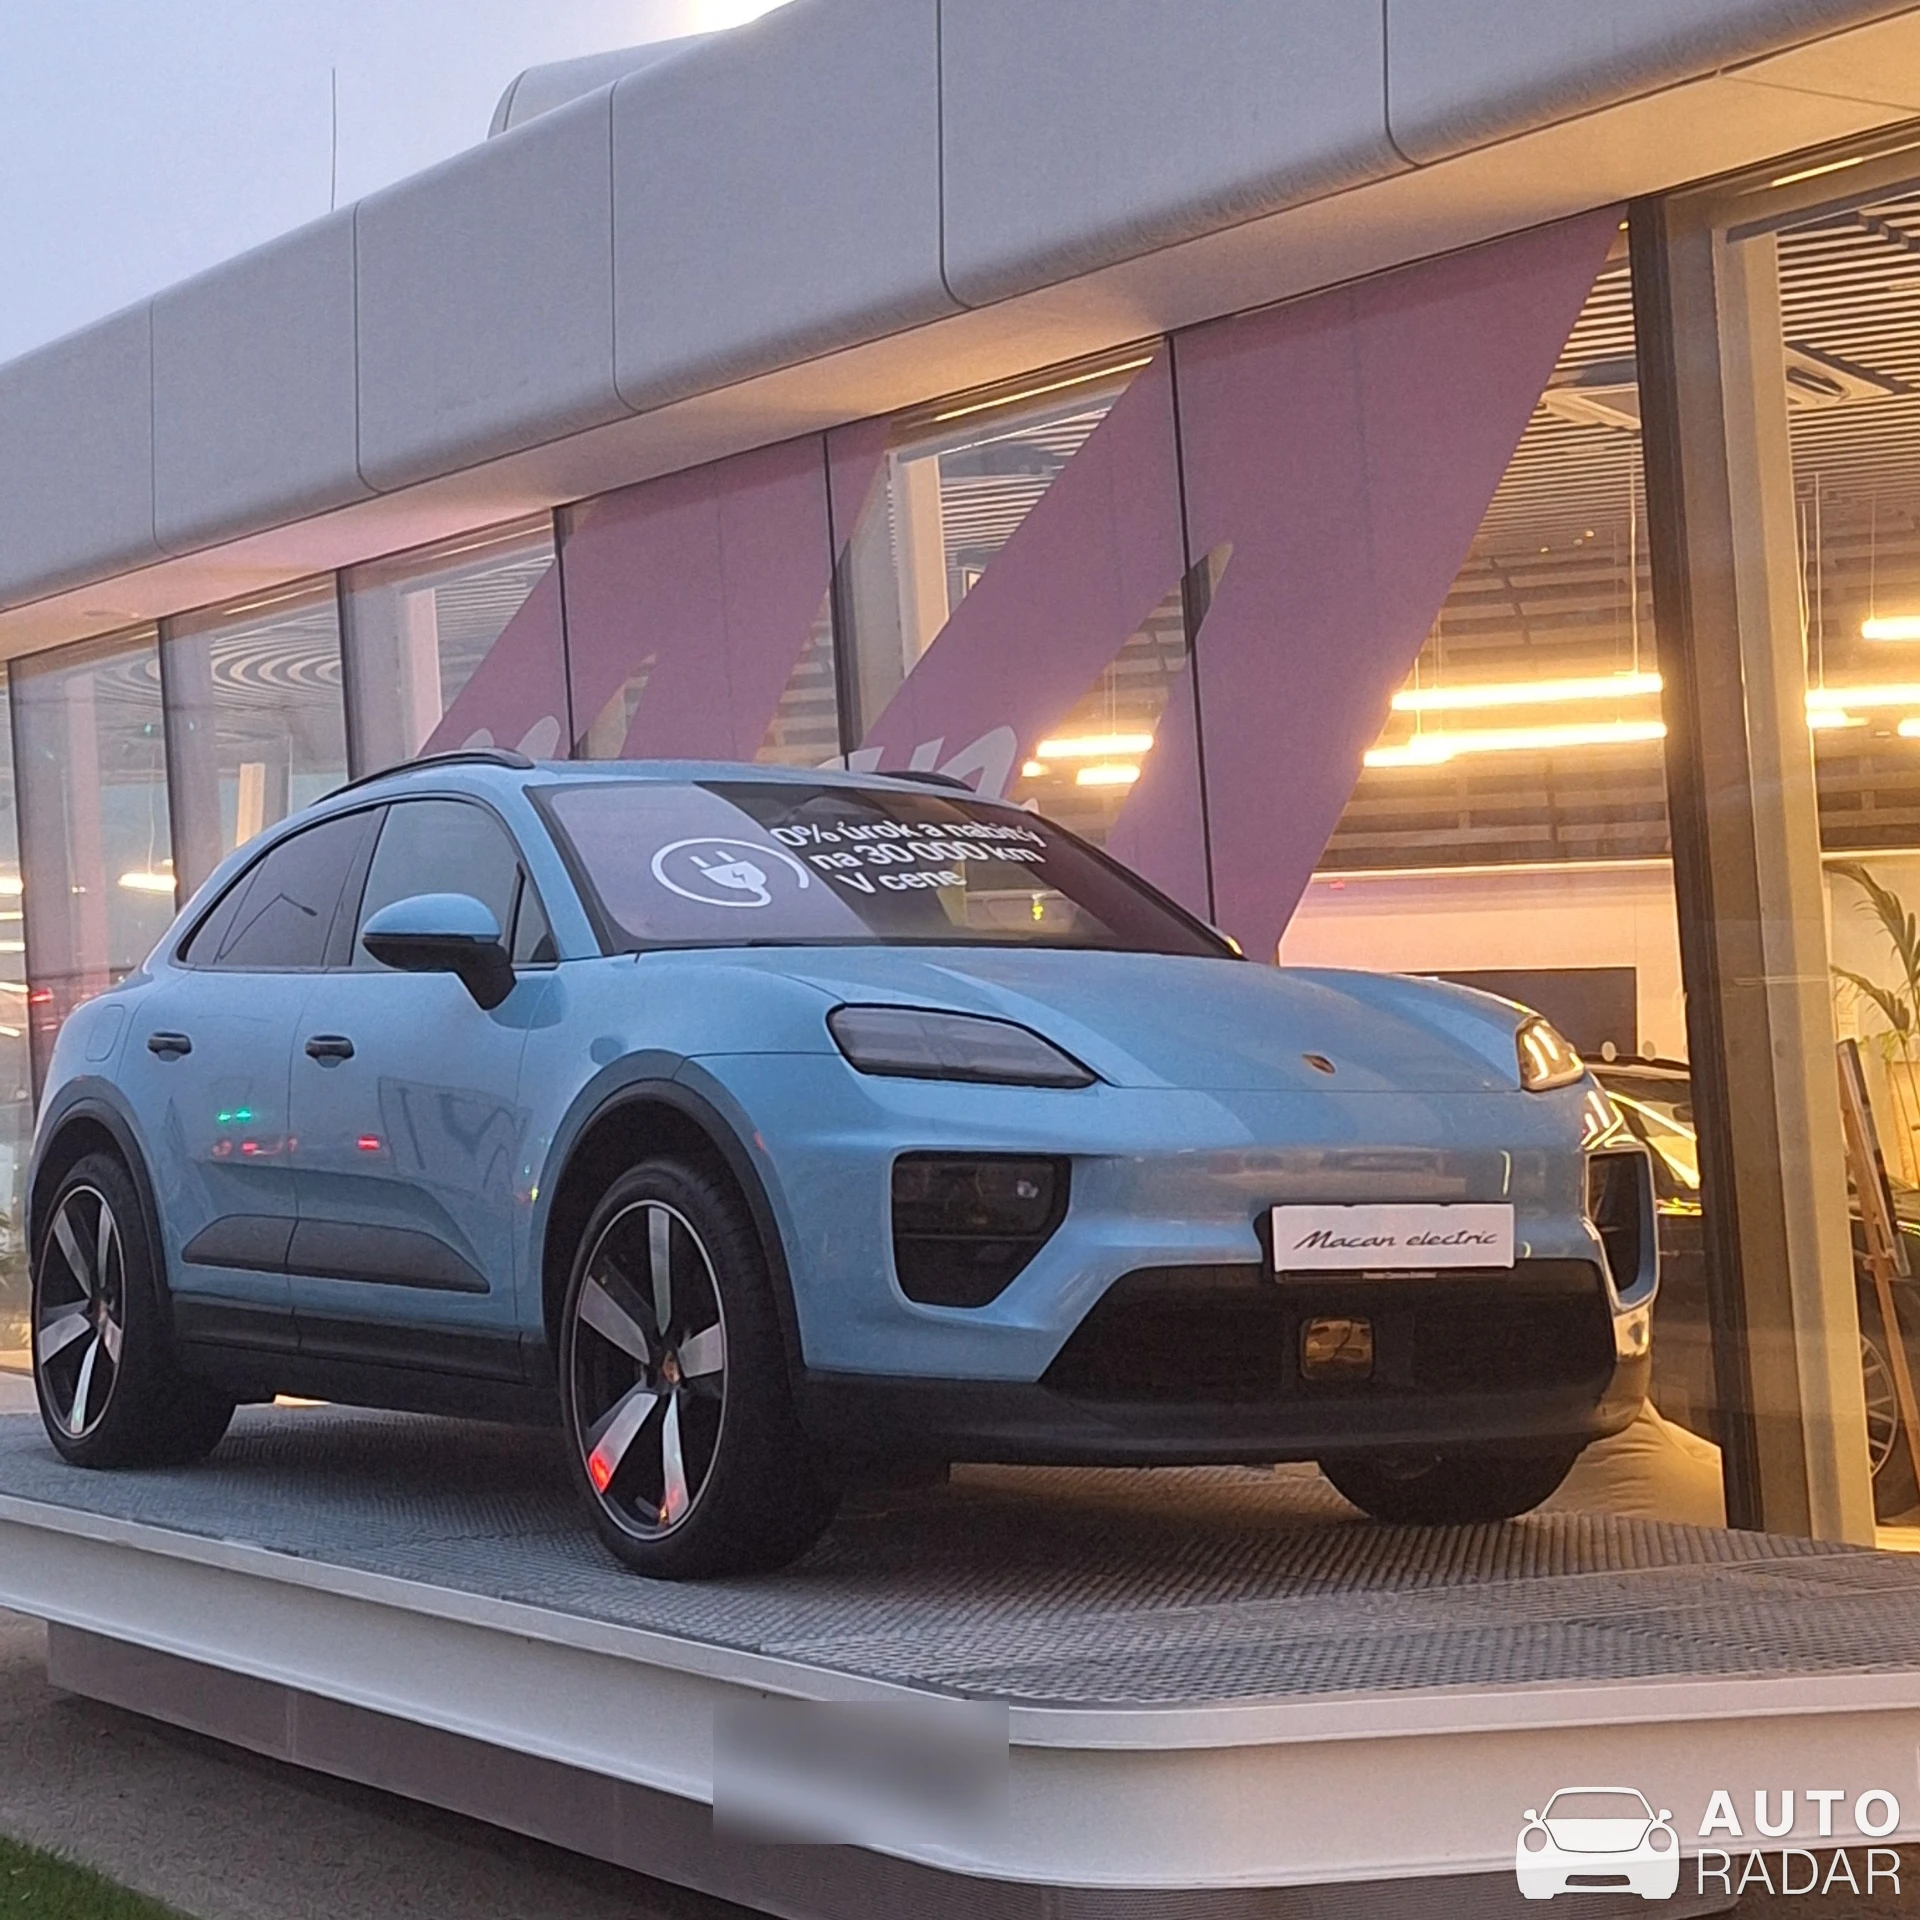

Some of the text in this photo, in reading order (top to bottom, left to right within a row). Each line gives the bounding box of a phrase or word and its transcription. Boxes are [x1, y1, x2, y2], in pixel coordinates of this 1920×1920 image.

[769, 823, 842, 847] 0%
[836, 819, 923, 839] úrok
[916, 823, 947, 838] a
[808, 841, 1046, 871] na 30 000 km
[878, 870, 967, 891] cene
[1292, 1229, 1498, 1251] Macan electric
